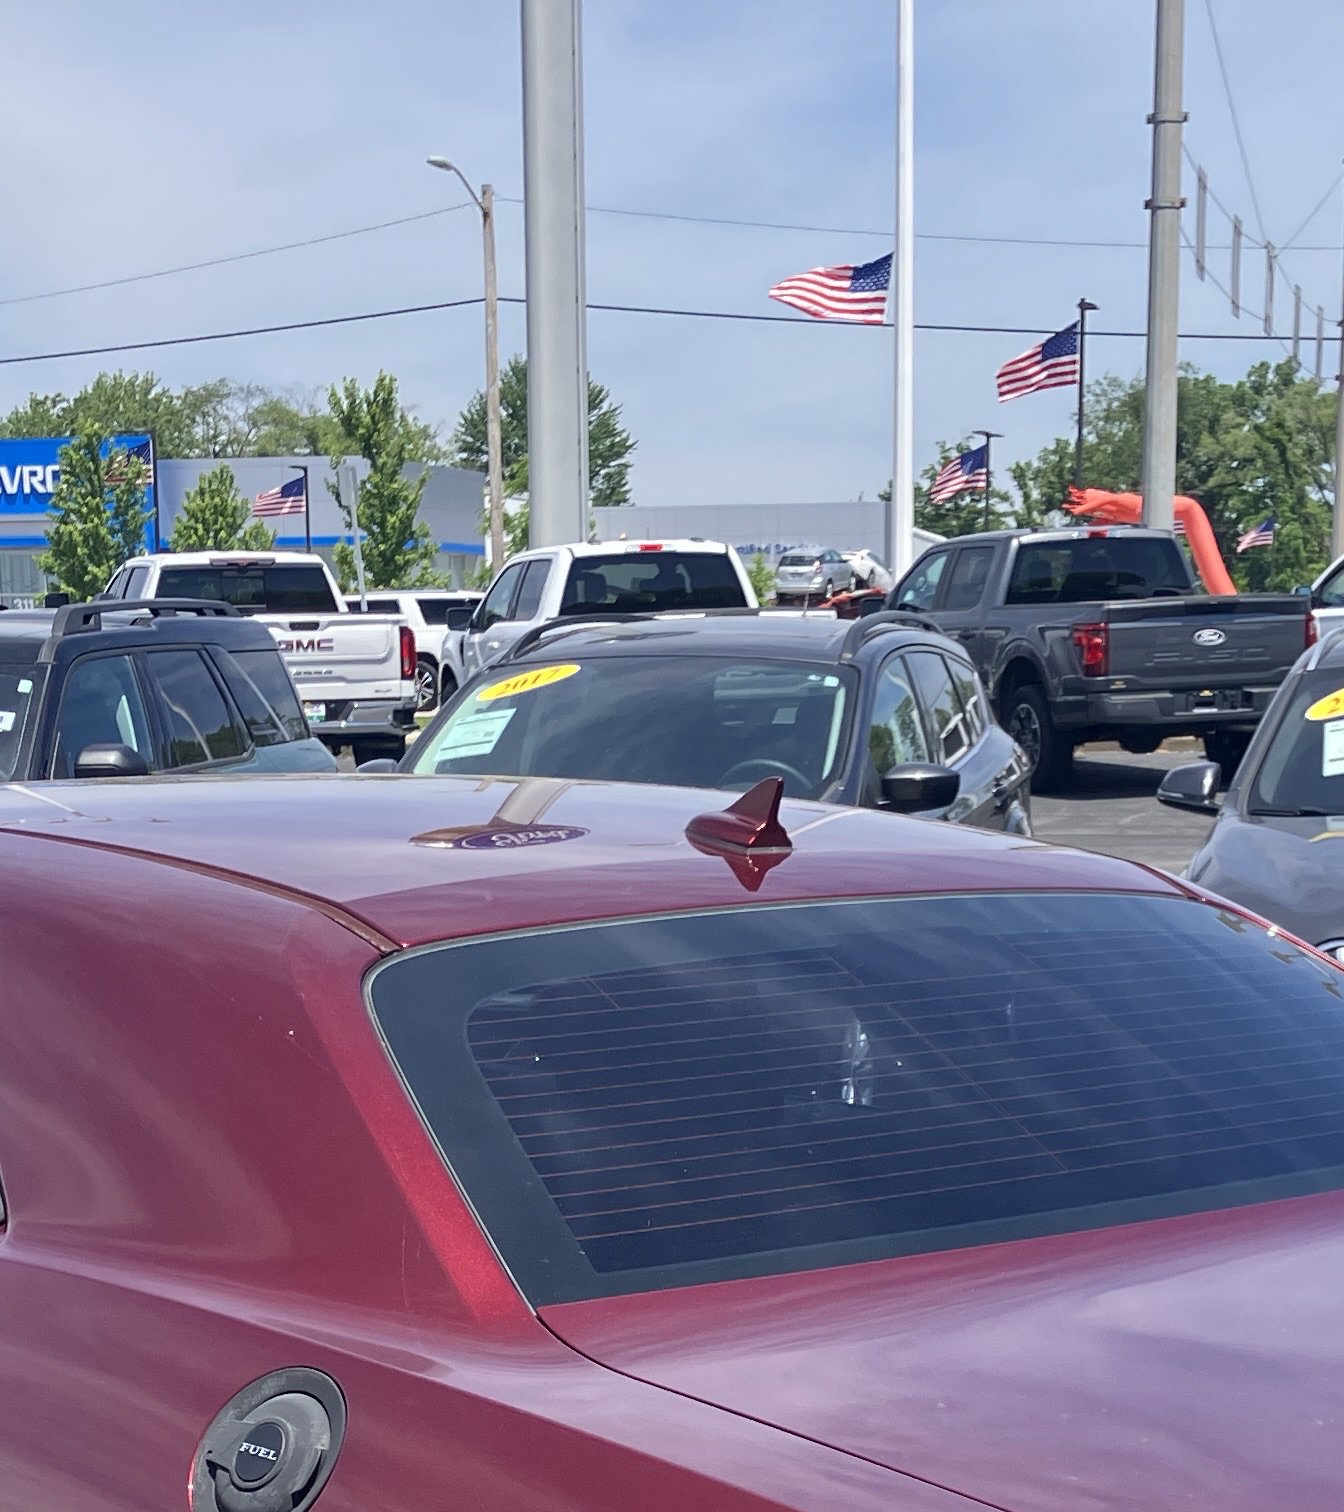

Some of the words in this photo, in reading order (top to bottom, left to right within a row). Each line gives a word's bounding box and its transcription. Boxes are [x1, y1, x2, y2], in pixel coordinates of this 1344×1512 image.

[277, 638, 334, 652] GMC
[495, 668, 561, 697] 2017
[239, 1441, 277, 1461] FUEL
